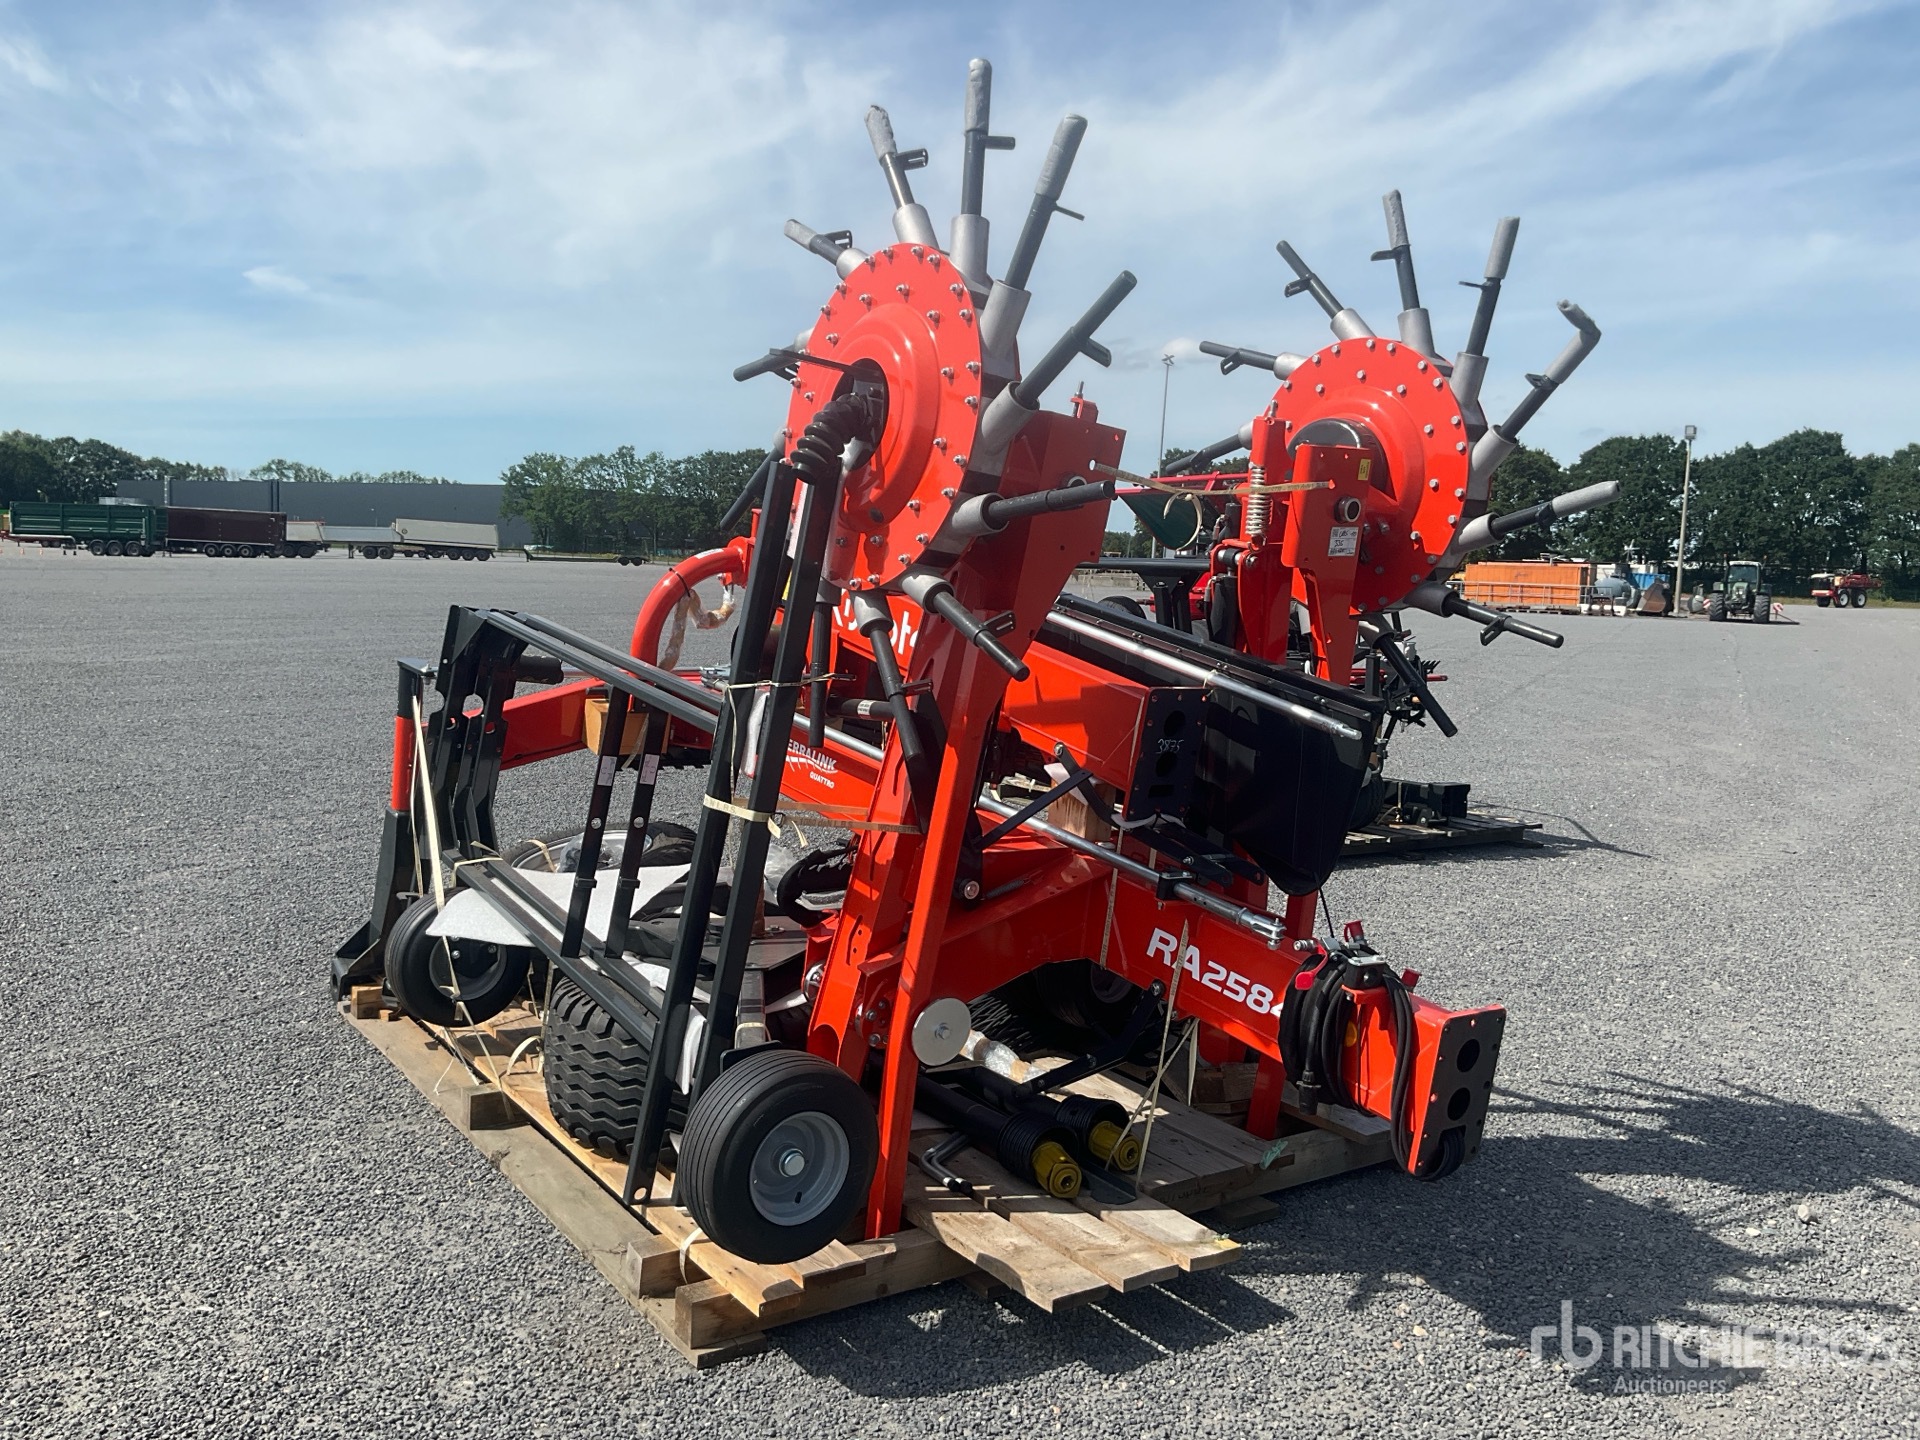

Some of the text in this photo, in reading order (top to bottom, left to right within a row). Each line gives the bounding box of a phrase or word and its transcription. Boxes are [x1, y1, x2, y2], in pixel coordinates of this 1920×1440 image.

[787, 738, 837, 770] ERRALINK
[809, 770, 835, 789] QUATTRO
[1146, 928, 1283, 1017] RA258
